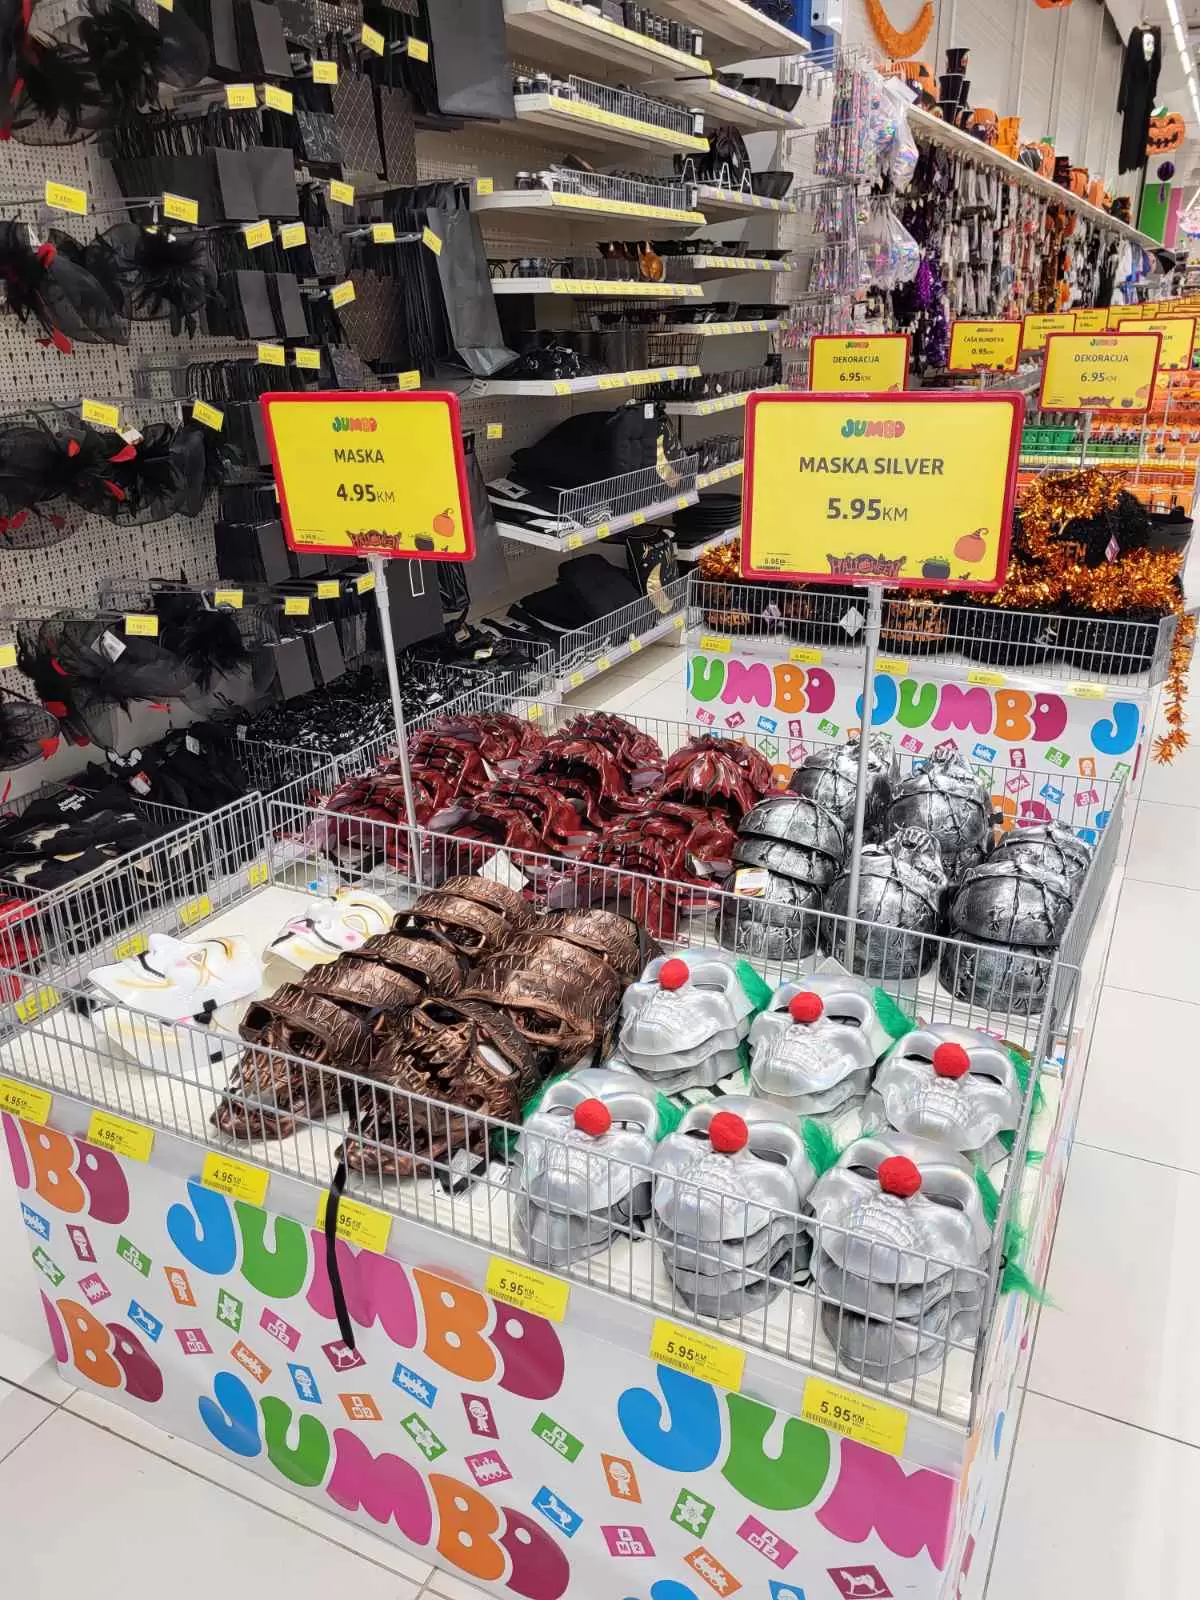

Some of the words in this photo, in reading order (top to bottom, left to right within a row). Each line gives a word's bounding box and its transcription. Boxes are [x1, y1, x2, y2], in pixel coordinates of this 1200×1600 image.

[832, 355, 880, 364] DEKORACIJA
[1073, 353, 1129, 363] DEKORACIJA
[332, 416, 378, 432] JUMBO
[841, 418, 905, 438] JUMBO
[334, 448, 385, 463] MASKA
[800, 456, 869, 474] MASKA
[873, 457, 944, 475] SILVER
[856, 674, 1067, 742] JUMBO
[166, 1175, 565, 1401] JUMBO
[198, 1371, 571, 1600] JUMBO
